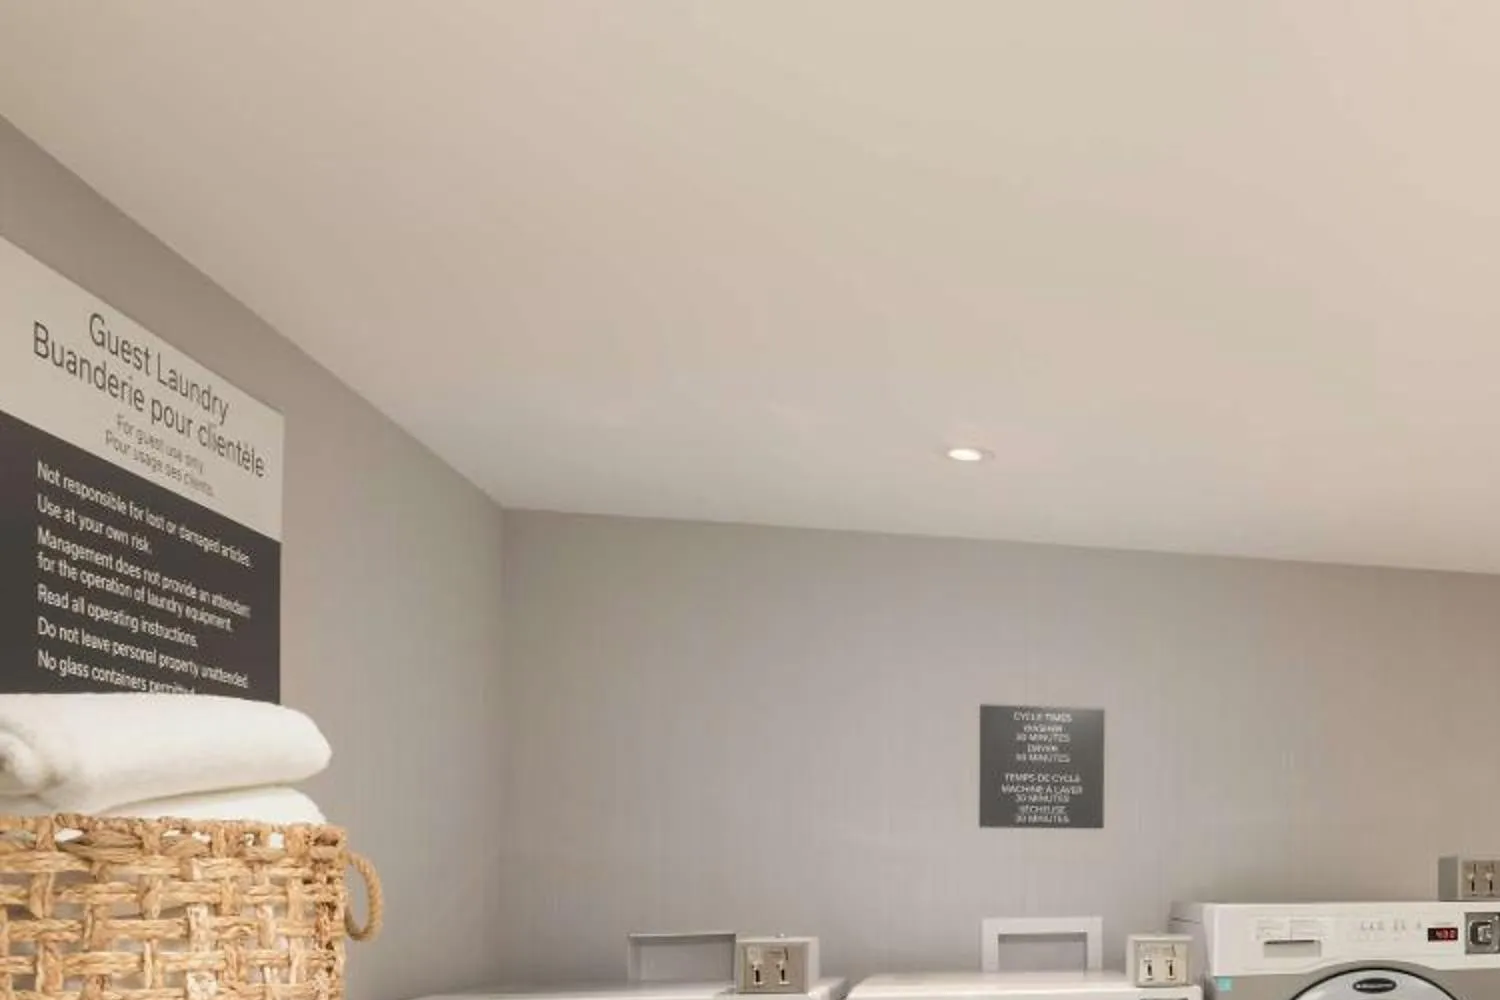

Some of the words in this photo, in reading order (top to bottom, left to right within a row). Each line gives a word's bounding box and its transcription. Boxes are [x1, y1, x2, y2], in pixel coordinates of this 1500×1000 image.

[33, 320, 145, 411] Buanderie
[151, 398, 194, 438] pour
[198, 423, 265, 477] clientèle
[89, 312, 151, 376] Guest
[156, 352, 229, 425] Laundry
[105, 429, 130, 454] Pour
[116, 414, 134, 436] For
[37, 459, 61, 488] Not
[63, 475, 127, 516] responsible
[129, 498, 144, 522] for
[146, 507, 165, 531] lost
[166, 519, 176, 533] or
[179, 525, 220, 554] damaged
[37, 494, 61, 519] Use
[64, 507, 76, 526] at
[77, 513, 104, 533] your
[105, 527, 129, 545] own
[37, 525, 114, 571] Management
[116, 555, 142, 580] does
[143, 568, 161, 587] not
[162, 574, 198, 599] provide
[37, 550, 56, 572] for
[58, 558, 78, 582] the
[80, 566, 132, 599] operation
[133, 585, 146, 602] of
[147, 589, 184, 618] laundry
[37, 583, 69, 610] Read
[71, 596, 85, 615] all
[87, 601, 140, 633] operating
[37, 616, 57, 638] Do
[59, 626, 80, 645] not
[81, 628, 111, 652] leave
[112, 638, 158, 665] personal
[158, 653, 200, 678] property
[37, 650, 57, 671] No
[59, 654, 90, 679] glass
[91, 665, 148, 692] containers
